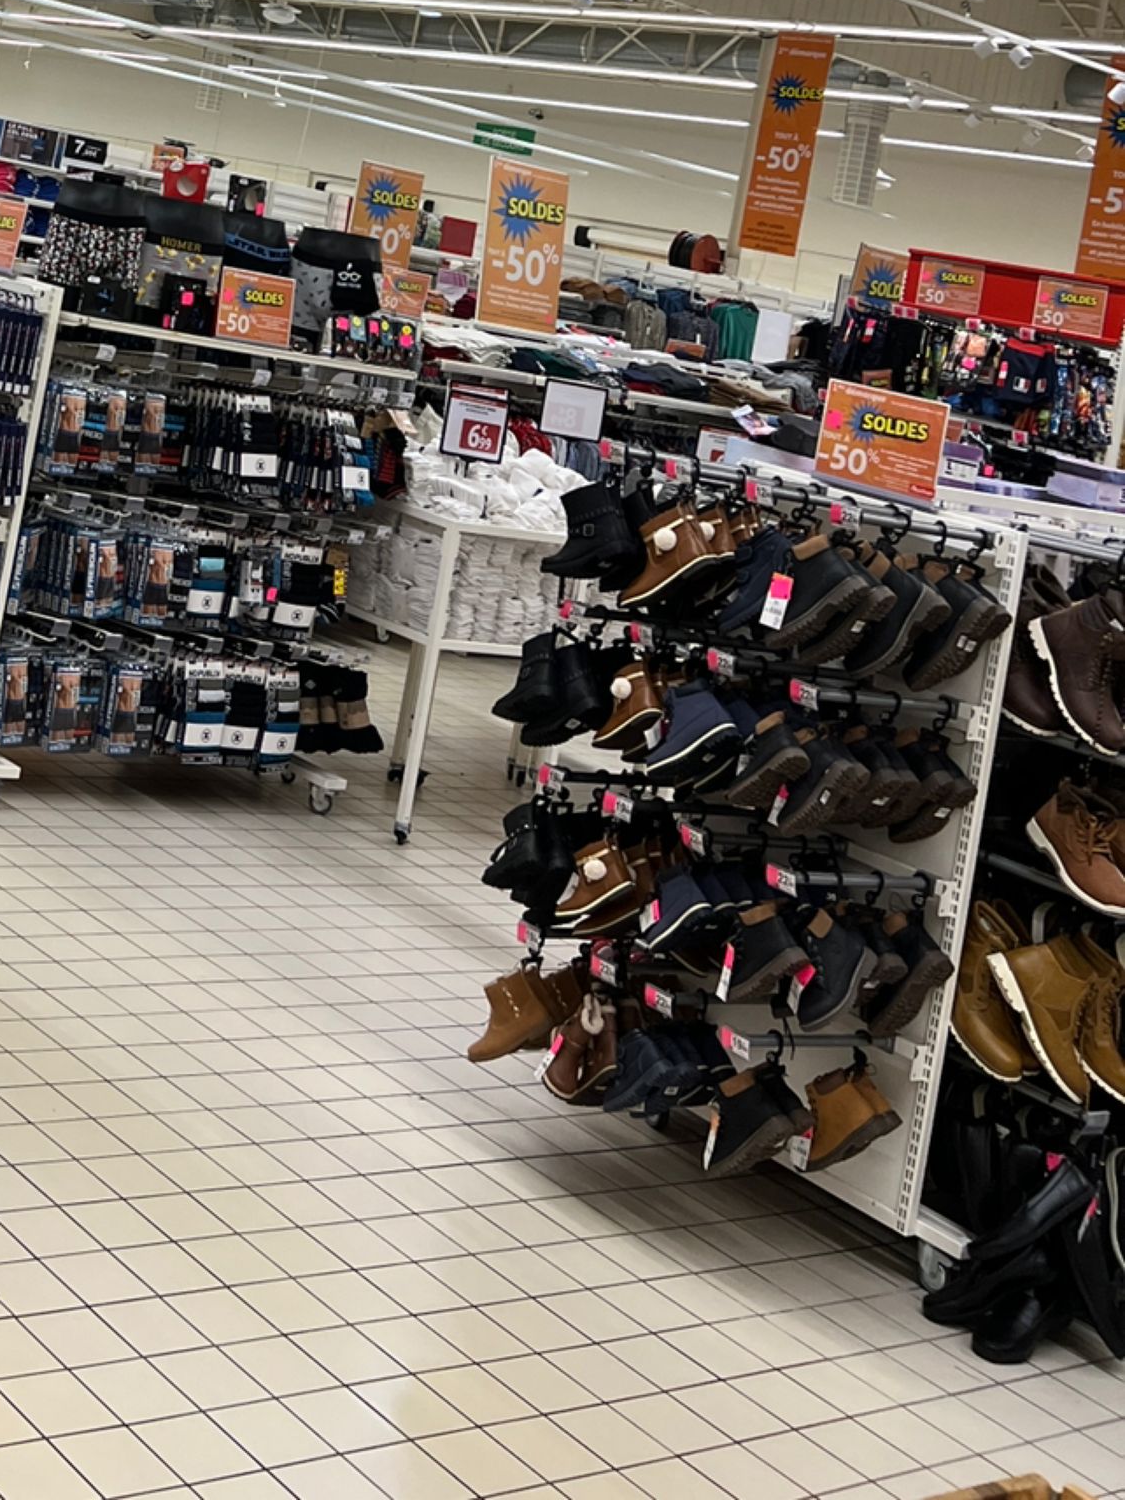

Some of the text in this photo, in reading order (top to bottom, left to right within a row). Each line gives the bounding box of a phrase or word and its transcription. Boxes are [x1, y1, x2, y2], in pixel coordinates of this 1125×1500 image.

[779, 85, 825, 101] SOLDES
[372, 188, 419, 210] SOLDES
[507, 196, 565, 224] SOLDES
[161, 236, 202, 254] HOMER
[941, 271, 976, 285] SOLDES
[245, 289, 285, 307] SOLDES
[868, 279, 903, 299] SOLD
[1059, 292, 1098, 306] SOLDES
[861, 412, 929, 442] SOLDES
